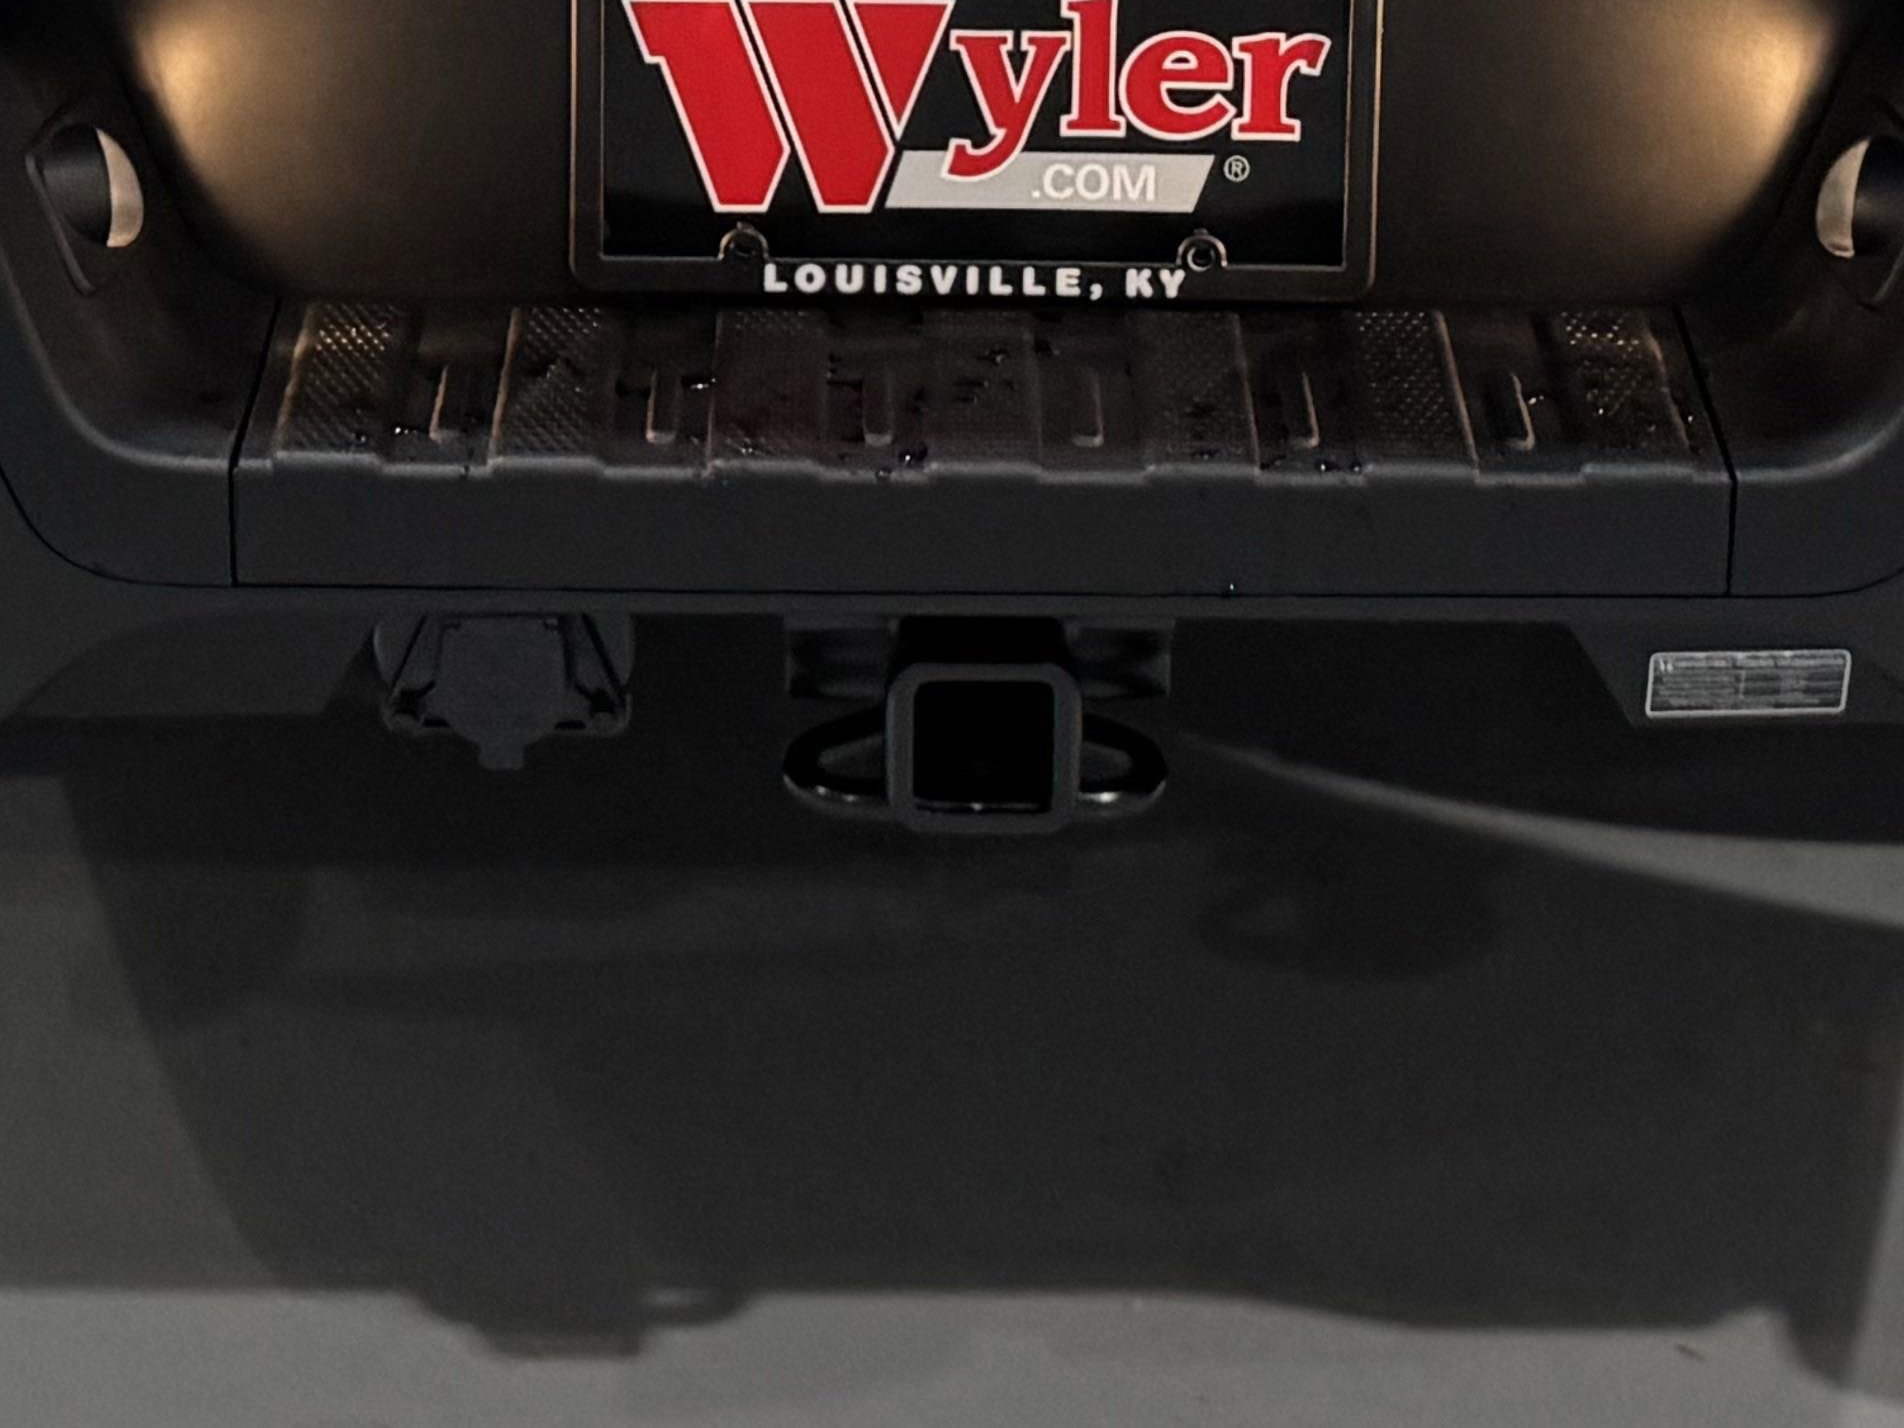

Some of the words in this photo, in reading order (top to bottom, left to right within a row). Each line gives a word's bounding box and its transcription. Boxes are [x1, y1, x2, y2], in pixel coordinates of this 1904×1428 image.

[1031, 163, 1157, 202] .COM
[762, 262, 1103, 301] LOUISVILLE,
[1124, 268, 1187, 299] KY
